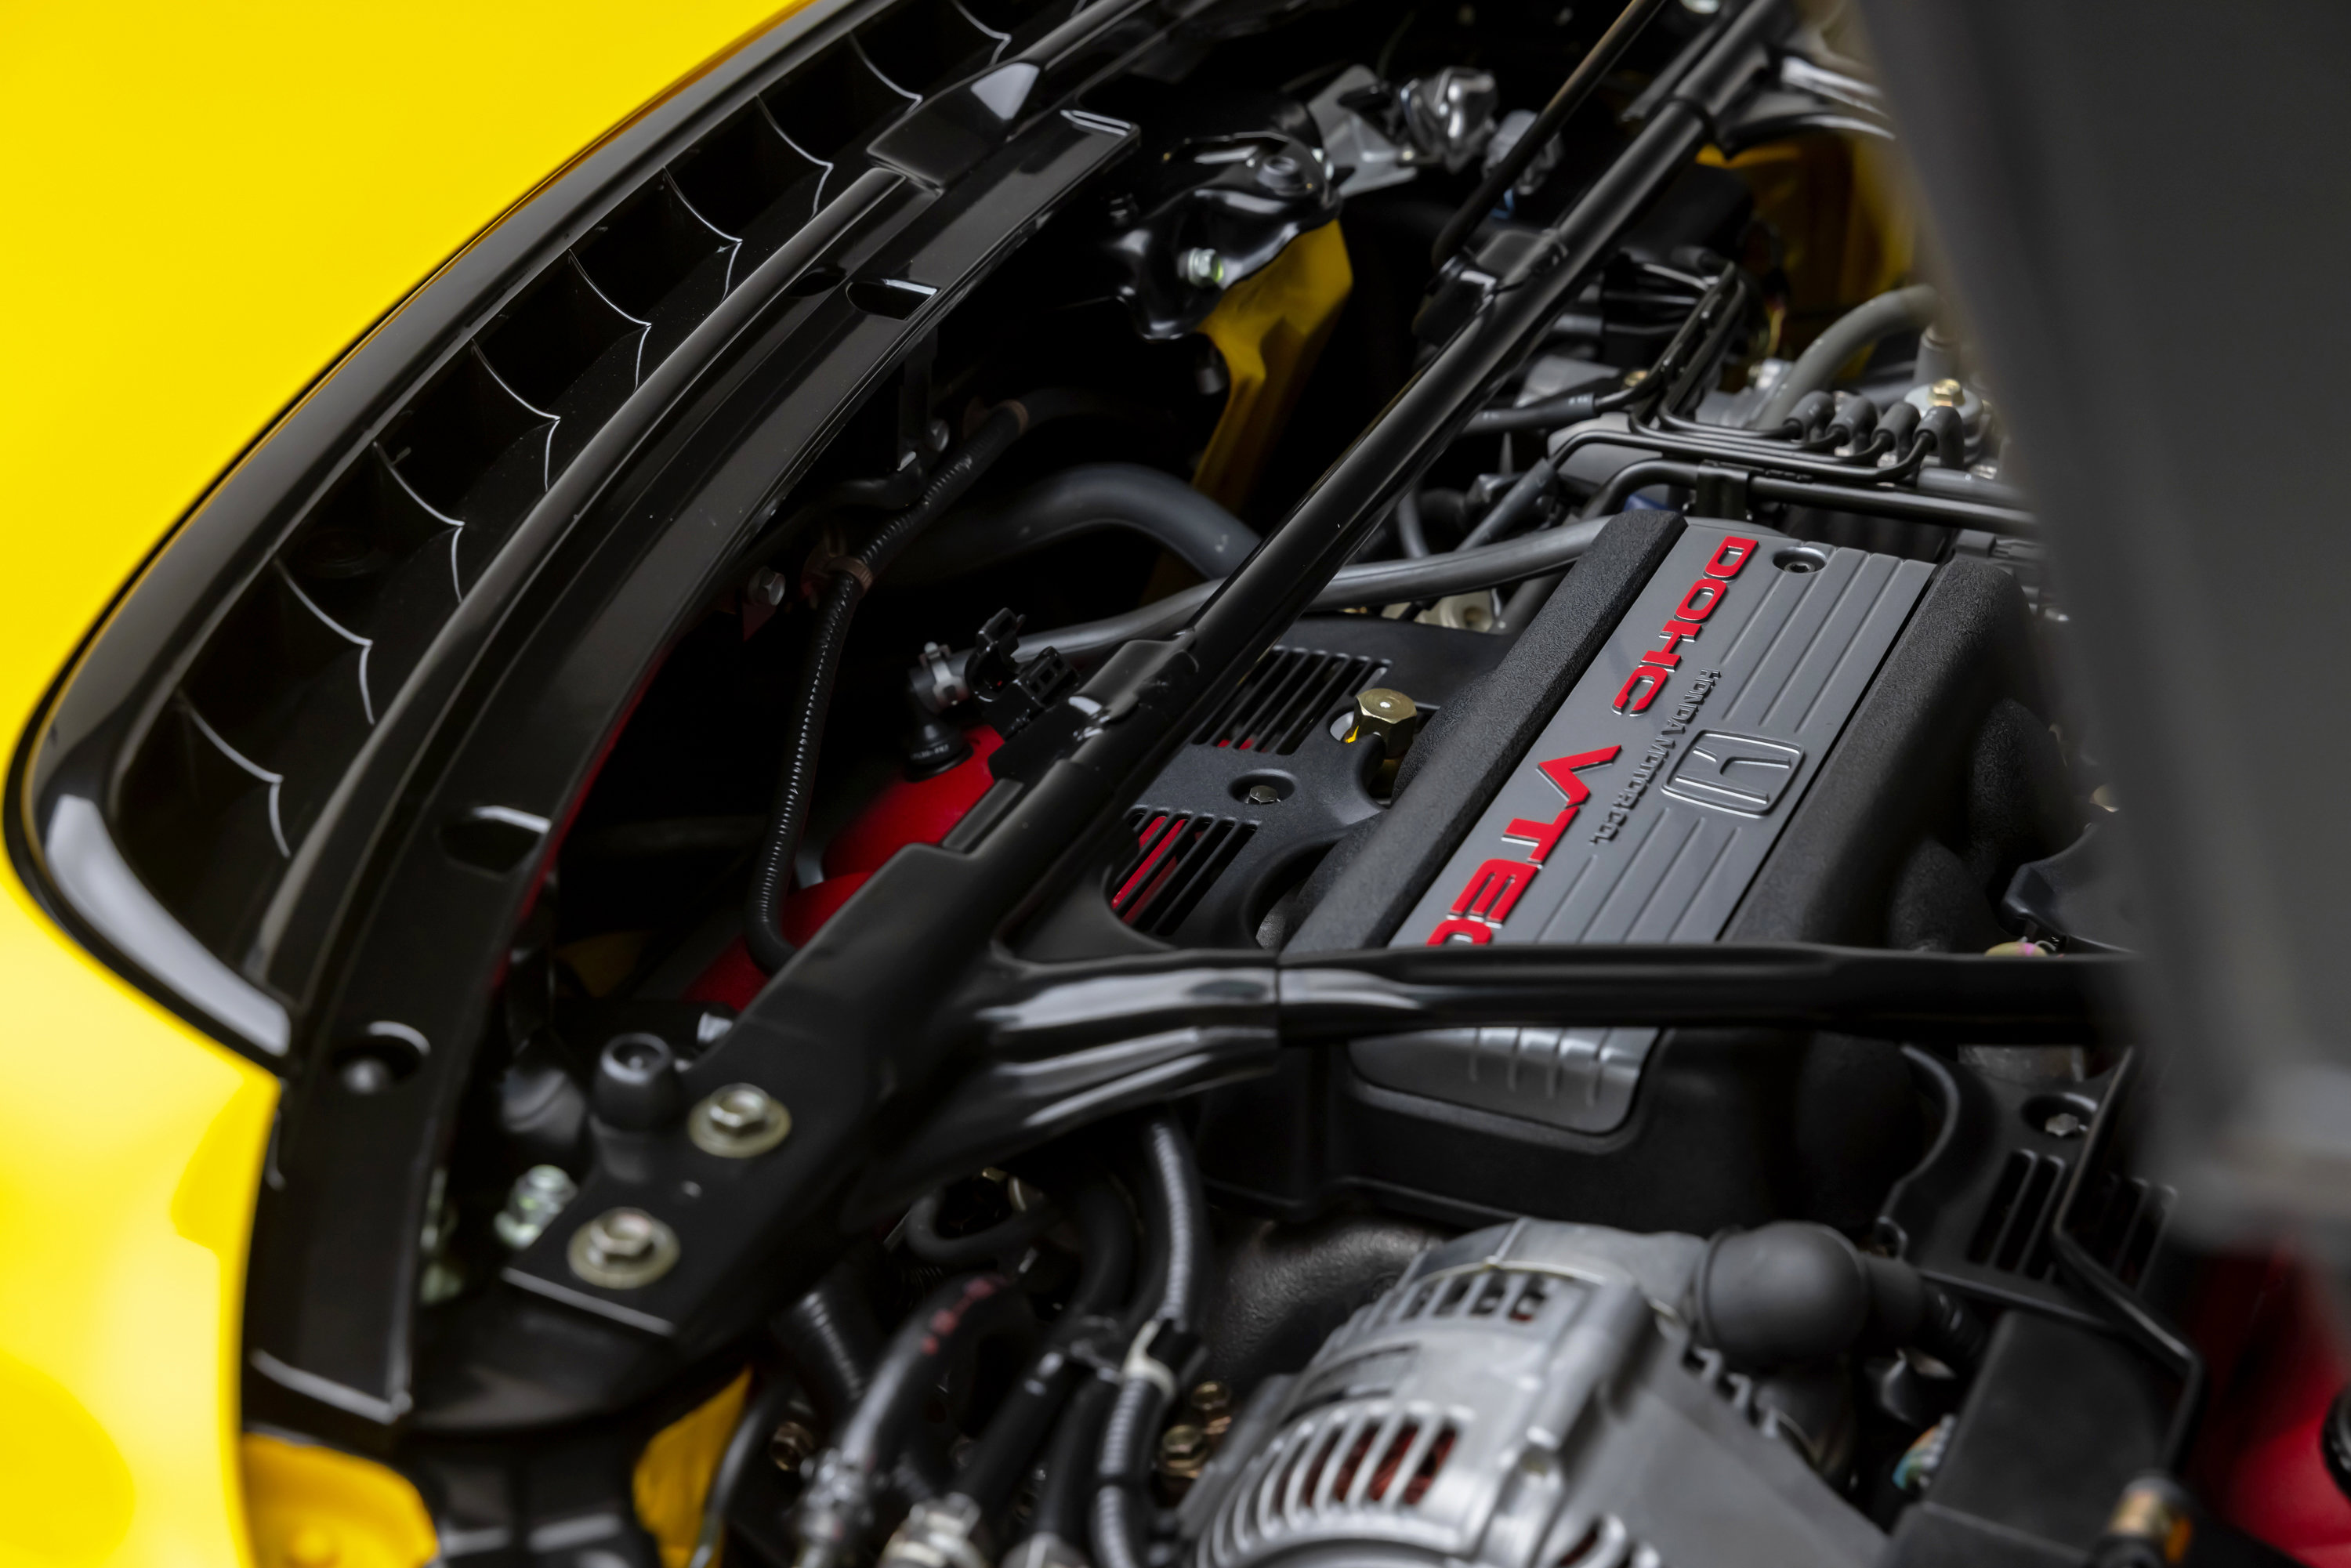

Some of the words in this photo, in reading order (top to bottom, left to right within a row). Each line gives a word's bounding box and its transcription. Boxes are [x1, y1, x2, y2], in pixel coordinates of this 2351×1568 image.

[1611, 536, 1759, 716] DOHC
[1661, 668, 1722, 735] HONDA
[1611, 734, 1675, 810] MOTOR
